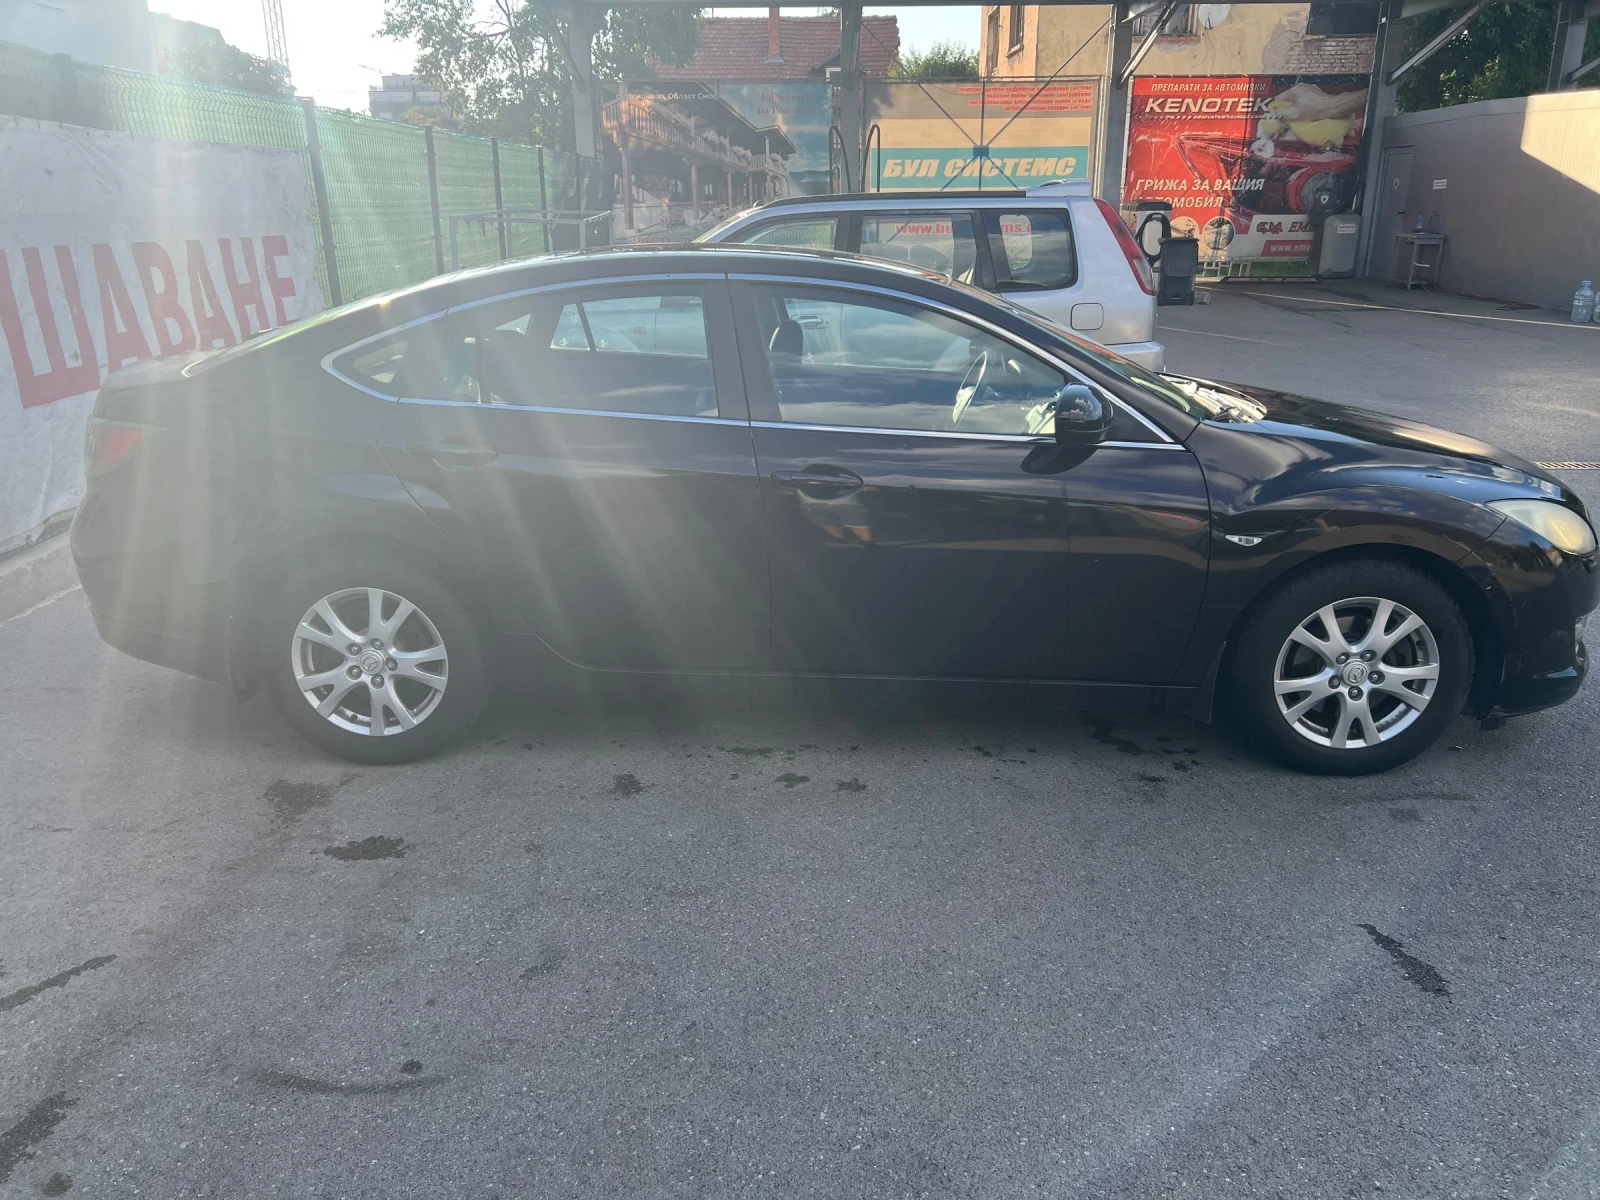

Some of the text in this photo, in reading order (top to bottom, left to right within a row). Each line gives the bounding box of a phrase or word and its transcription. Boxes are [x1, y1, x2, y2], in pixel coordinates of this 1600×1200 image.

[1151, 83, 1266, 92] ПРЕПАРАТИ ЗА АВТОМИВКИ
[667, 91, 696, 99] Област
[1145, 97, 1271, 113] KENOTEK
[883, 157, 1077, 178] БУЛ СИСТЕМС
[1135, 179, 1187, 191] ГРИЖА
[1191, 179, 1210, 191] ЗА
